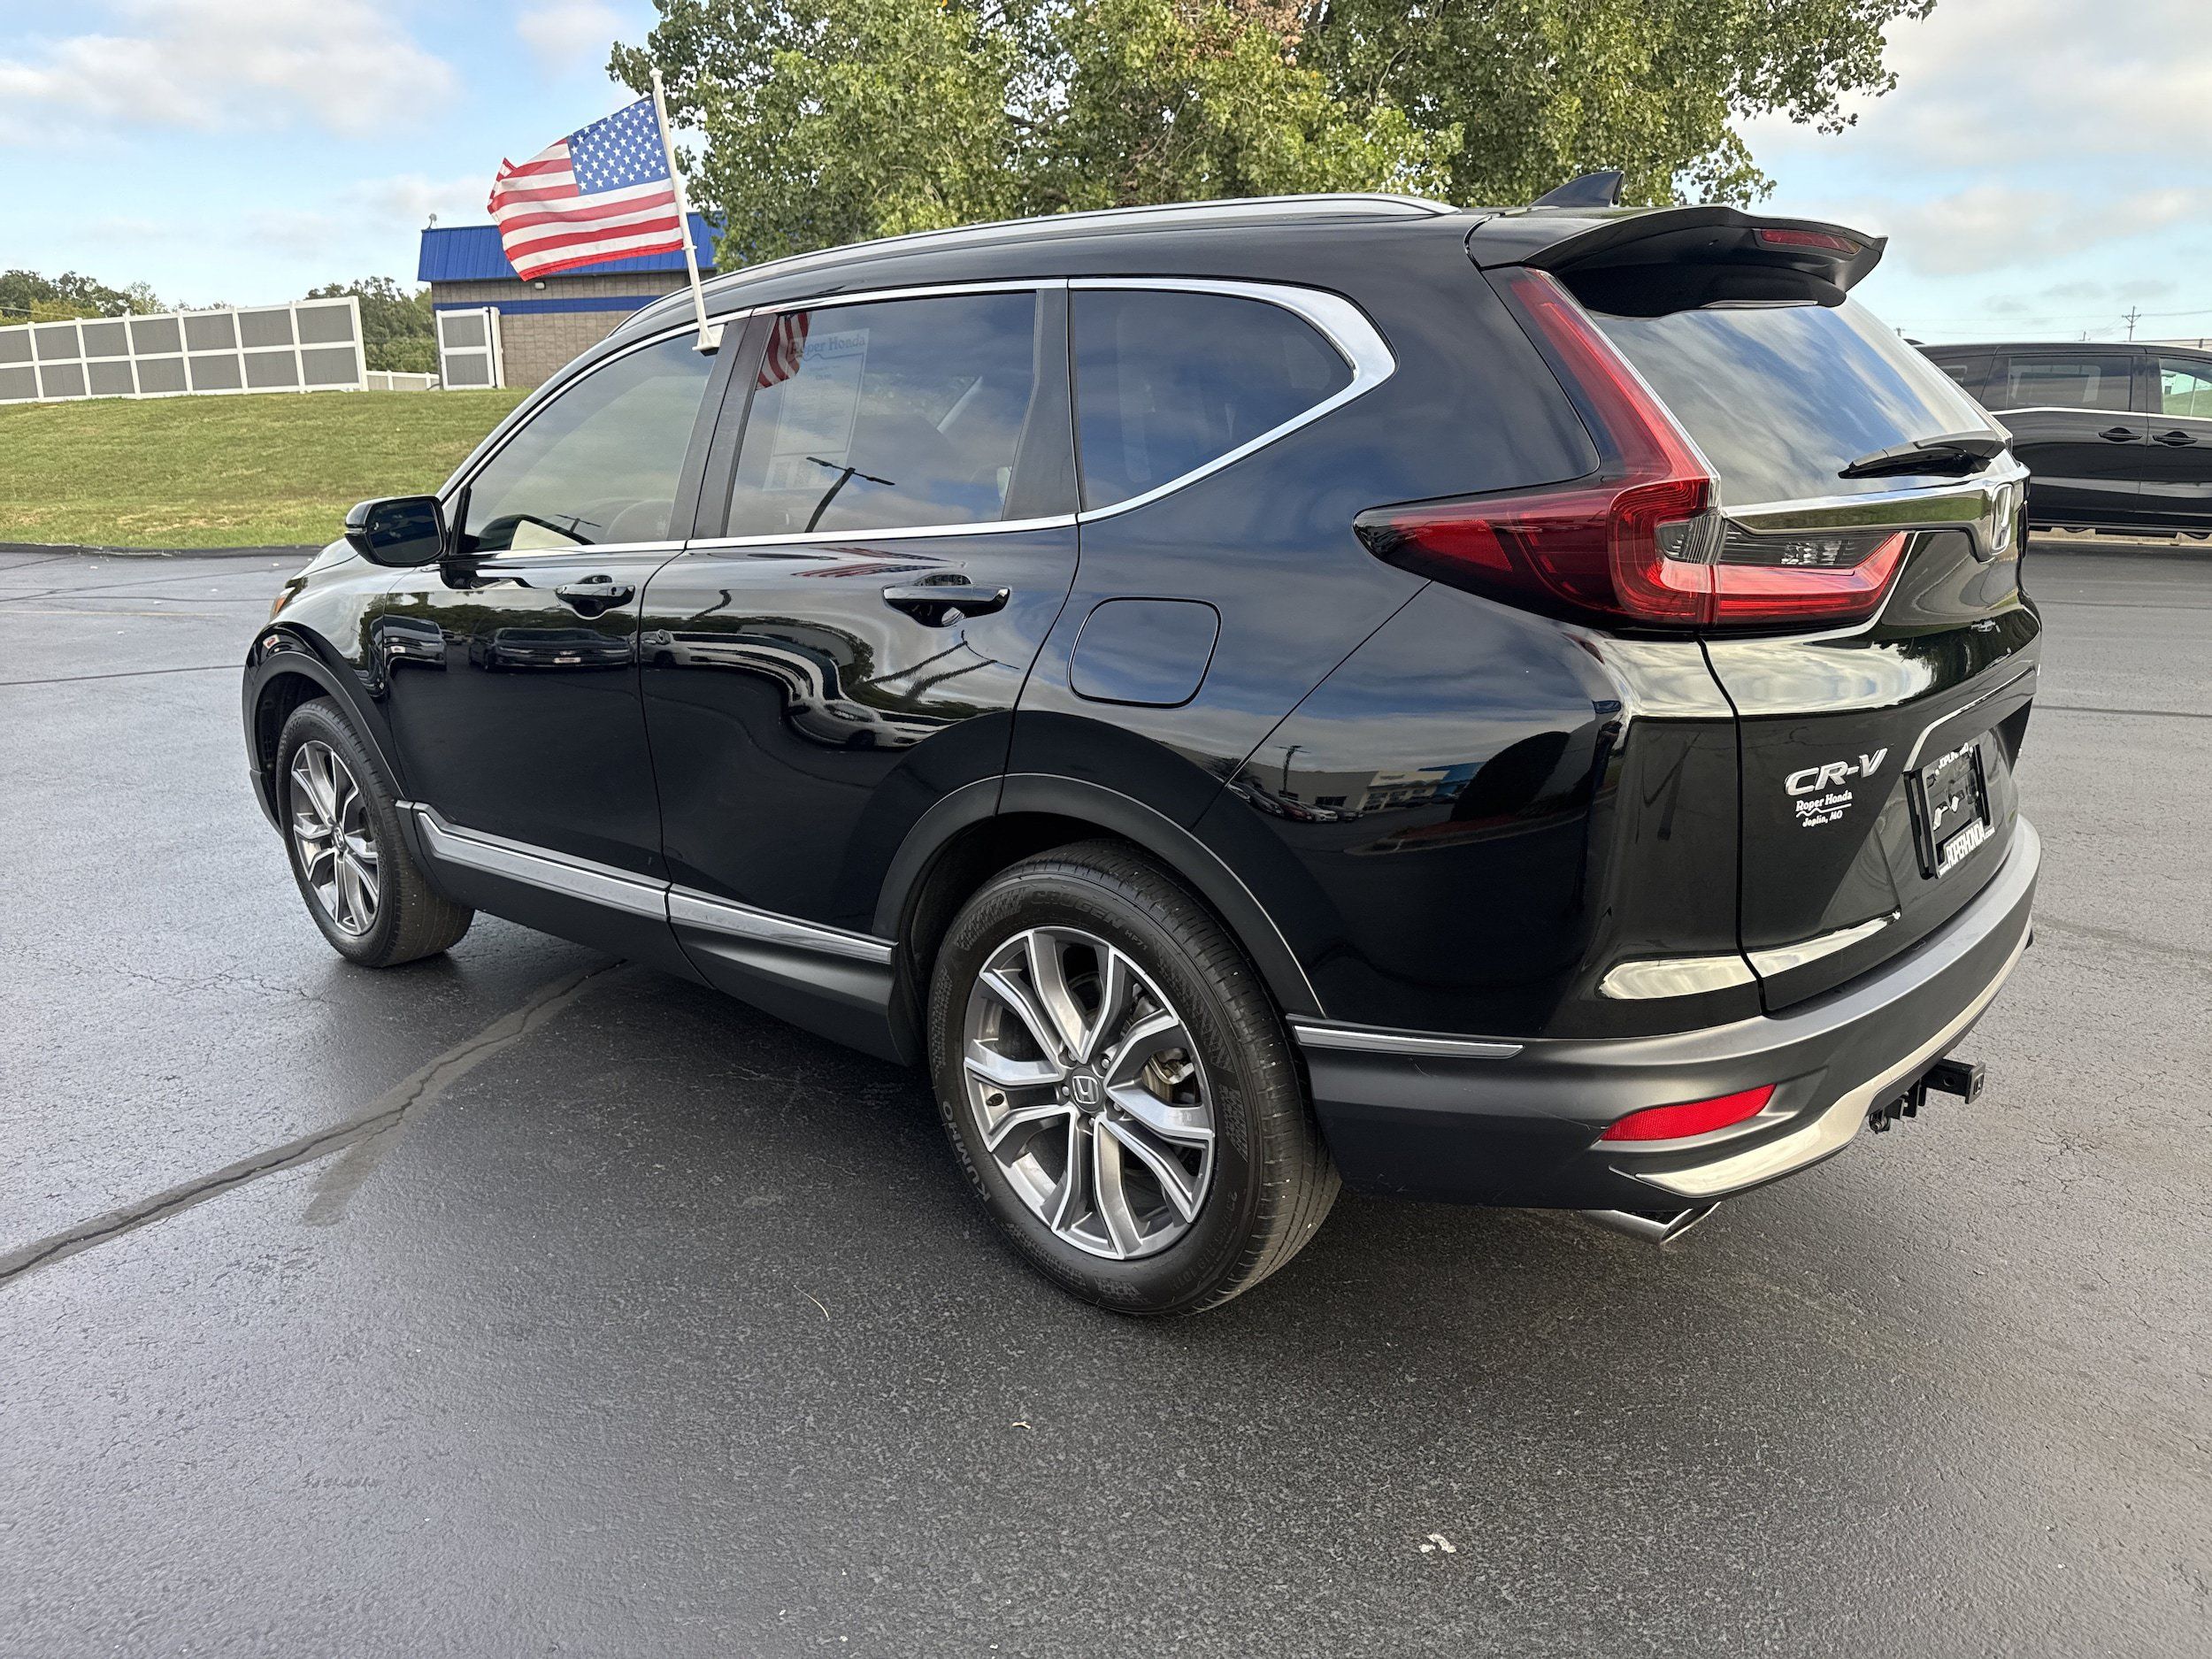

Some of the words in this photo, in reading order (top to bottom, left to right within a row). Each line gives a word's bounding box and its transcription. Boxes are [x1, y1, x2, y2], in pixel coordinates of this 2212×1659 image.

[828, 334, 866, 351] Honda
[1785, 748, 1888, 795] CR-V
[1795, 798, 1824, 812] Roper
[1824, 790, 1853, 805] Honda
[1802, 815, 1828, 827] Joplin,
[1829, 810, 1843, 820] MO
[942, 1100, 992, 1202] KUMHO
